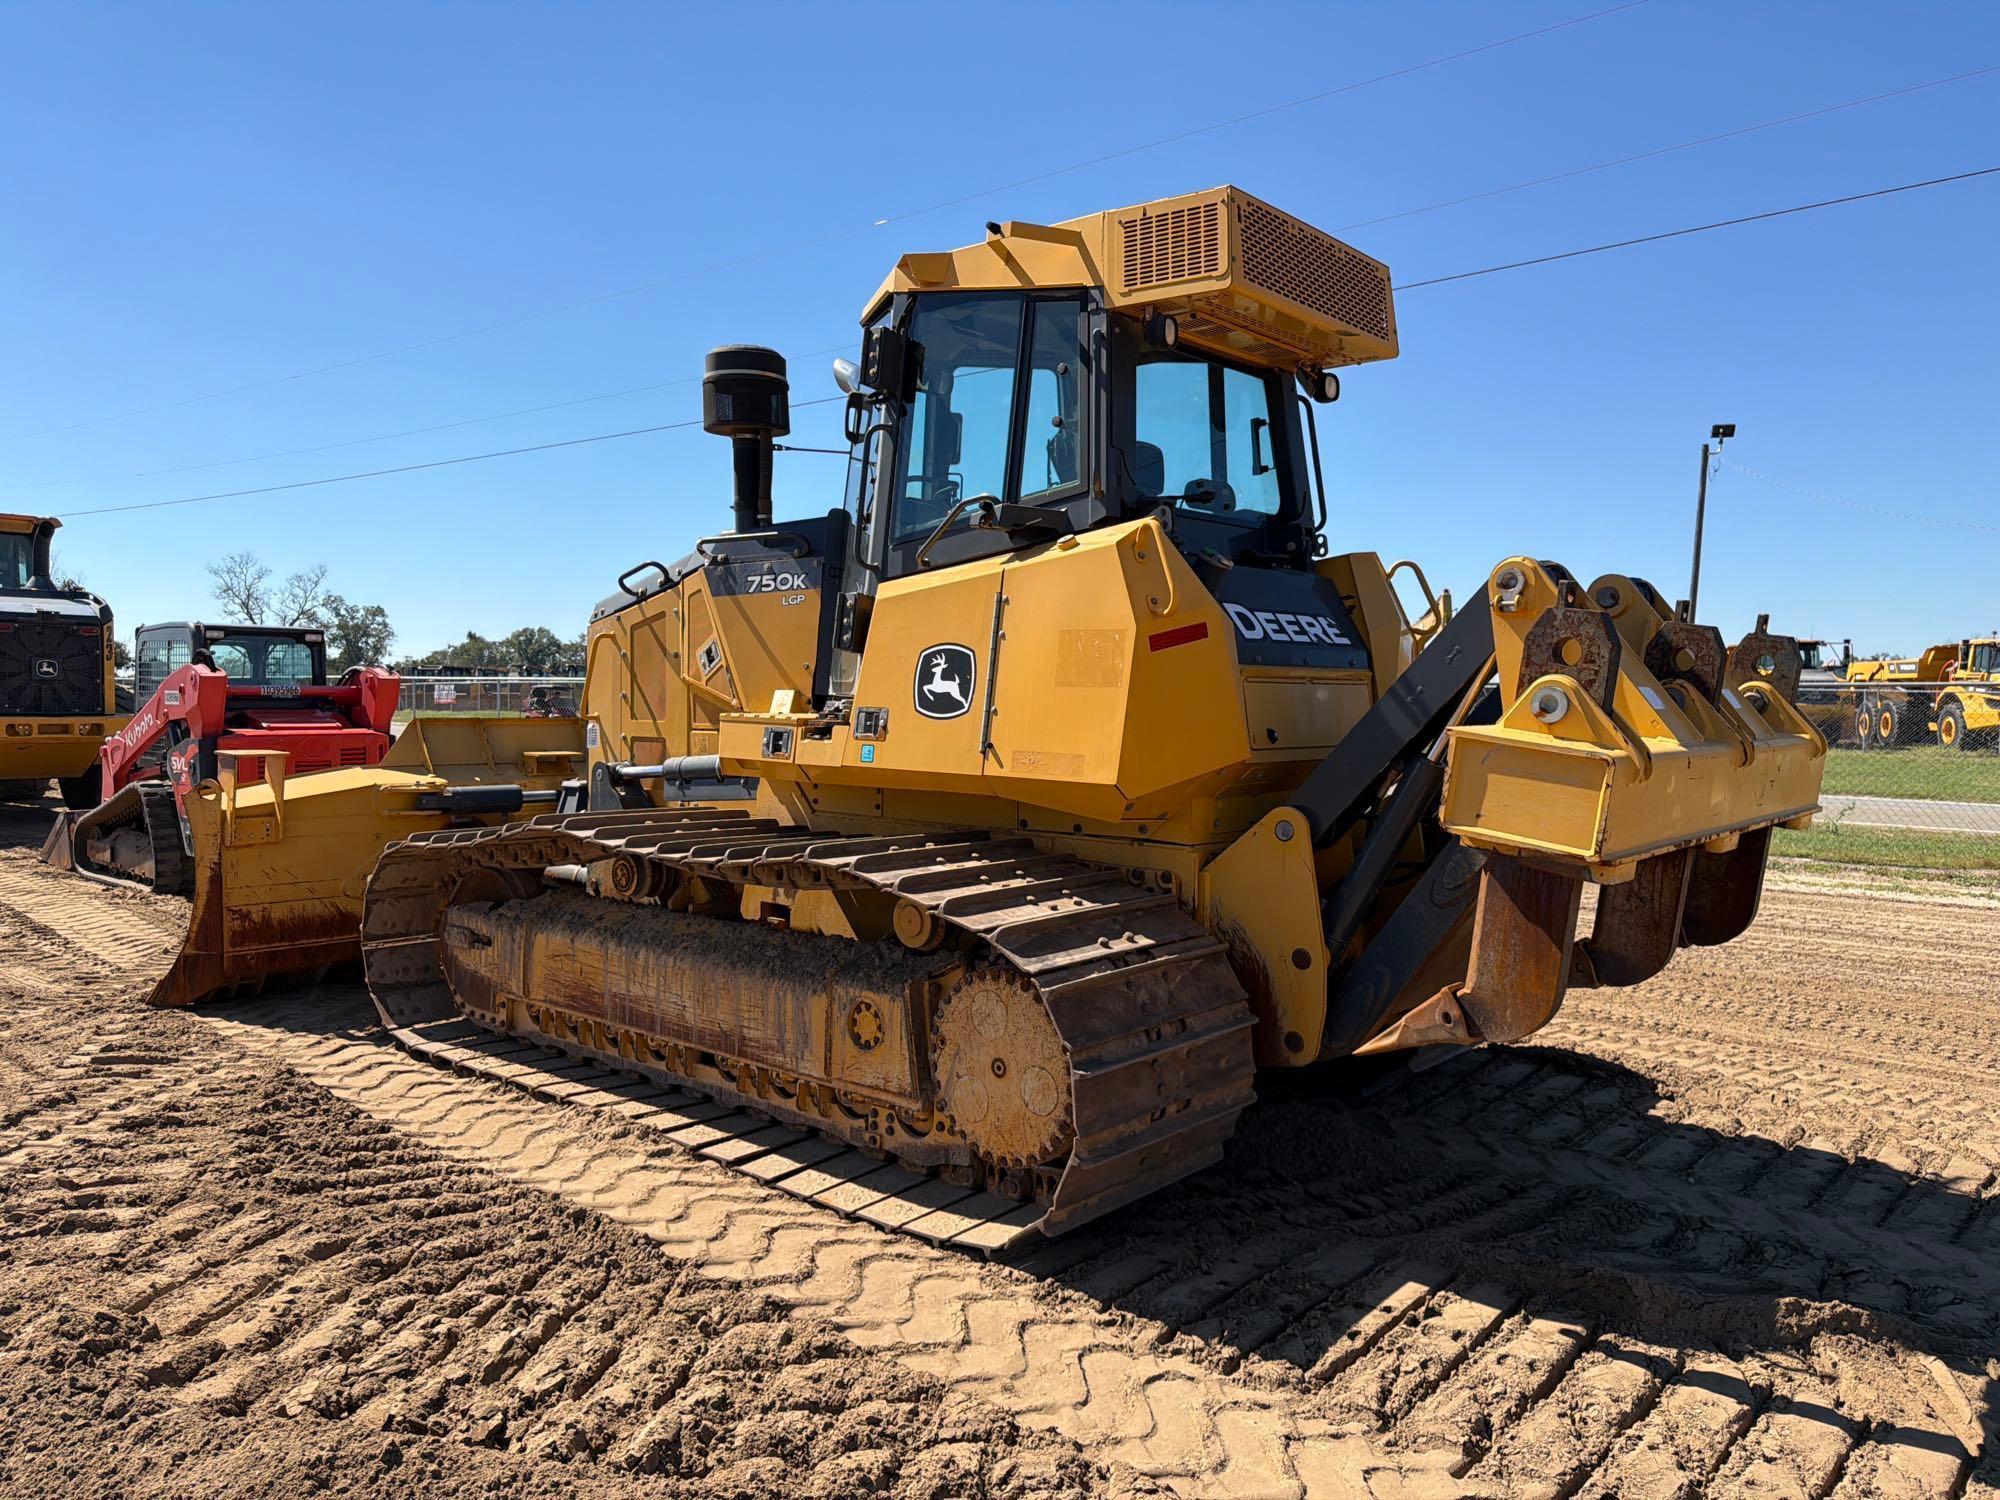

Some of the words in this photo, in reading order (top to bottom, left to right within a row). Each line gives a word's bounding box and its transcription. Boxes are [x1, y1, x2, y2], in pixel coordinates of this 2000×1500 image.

[746, 573, 807, 593] 750K
[782, 595, 806, 606] LGP
[1223, 602, 1352, 645] DEERE
[125, 713, 154, 747] Kubota
[171, 756, 188, 771] SVL
